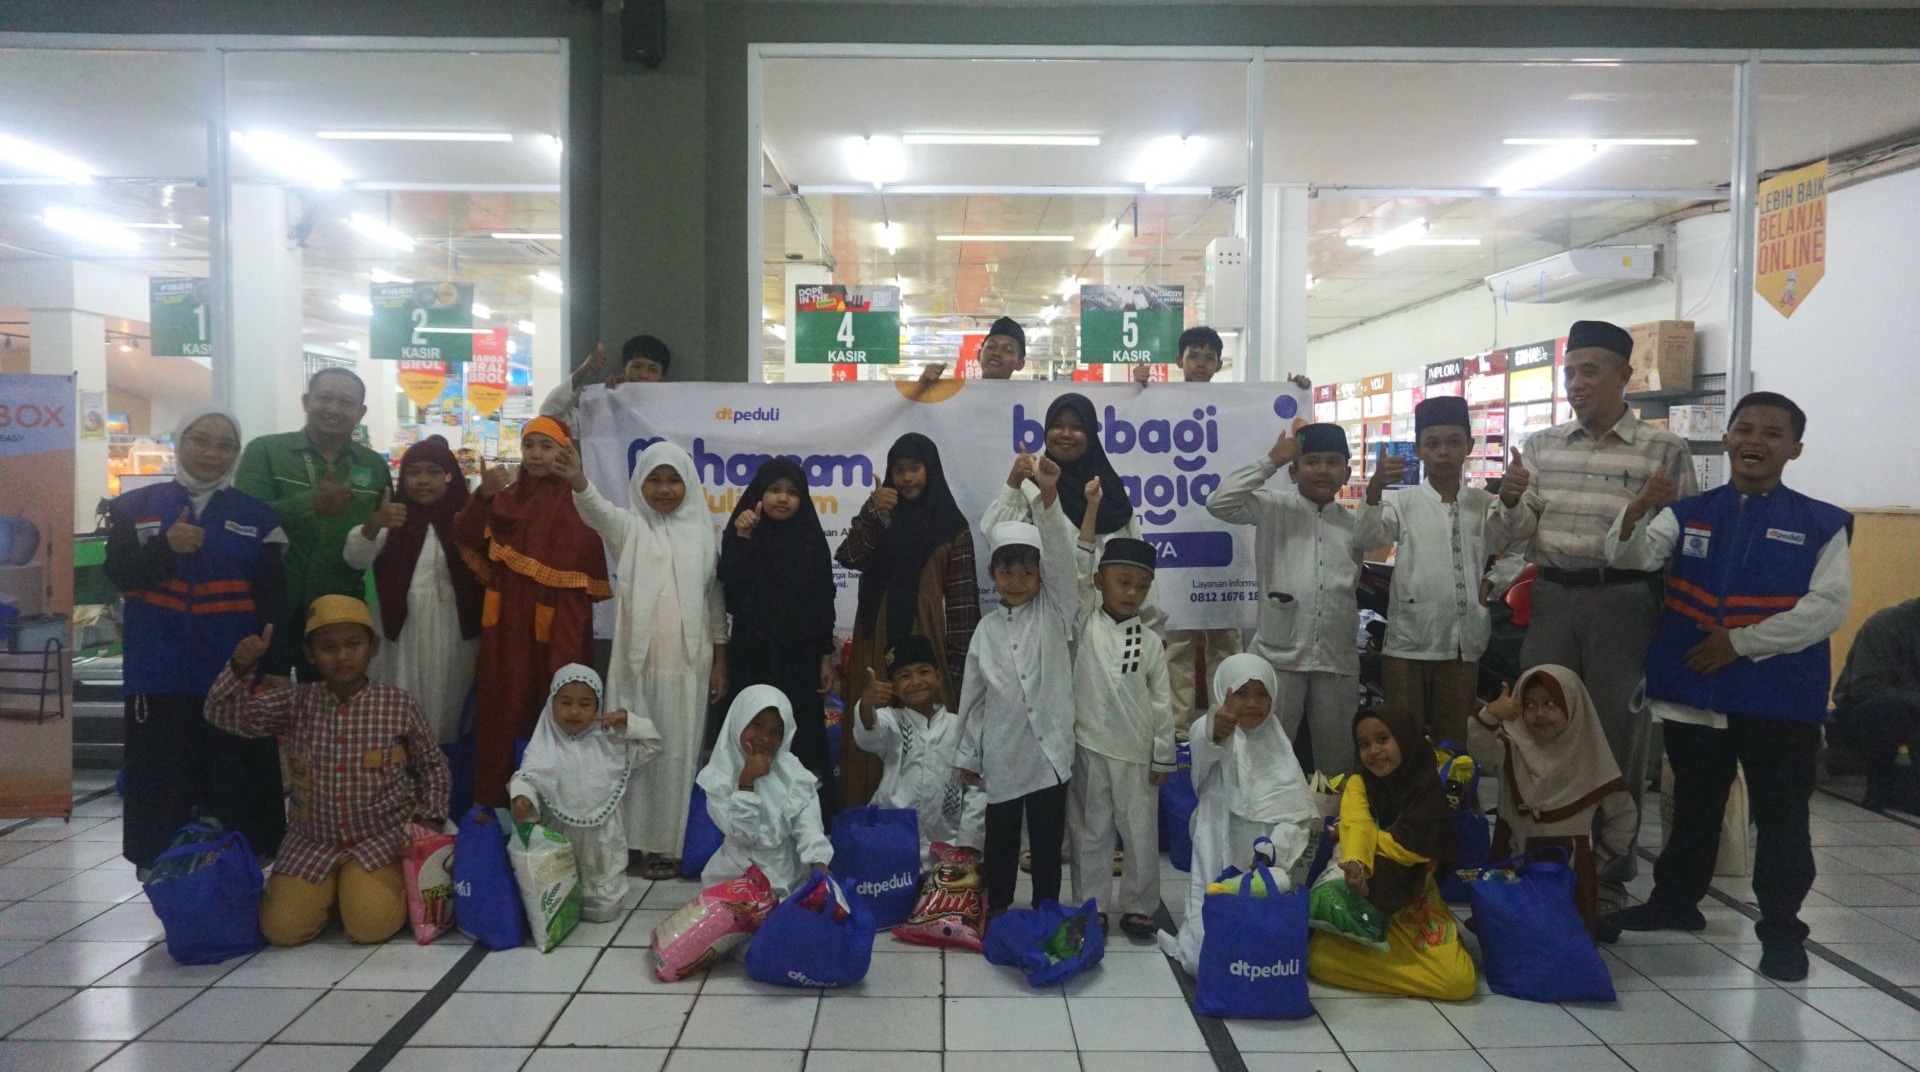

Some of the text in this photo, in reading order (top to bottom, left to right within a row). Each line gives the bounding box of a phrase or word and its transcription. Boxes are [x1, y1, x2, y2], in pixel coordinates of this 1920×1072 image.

[1759, 175, 1825, 214] LEBIH BAIK
[1758, 201, 1824, 243] BELANJA
[1758, 230, 1824, 276] ONLINE
[193, 304, 206, 341] 1
[411, 308, 428, 345] 2
[836, 311, 855, 349] 4
[1122, 311, 1139, 348] 5
[401, 347, 440, 359] KASIR
[827, 350, 867, 362] KASIR
[1112, 350, 1151, 362] KASIR
[467, 373, 505, 384] BROL
[714, 407, 780, 424] dtpeduli
[1192, 578, 1257, 589] Layanan Informa
[1190, 591, 1259, 602] 0812 1676 18
[856, 871, 913, 898] dtpeduli
[1229, 959, 1299, 981] dtpeduli
